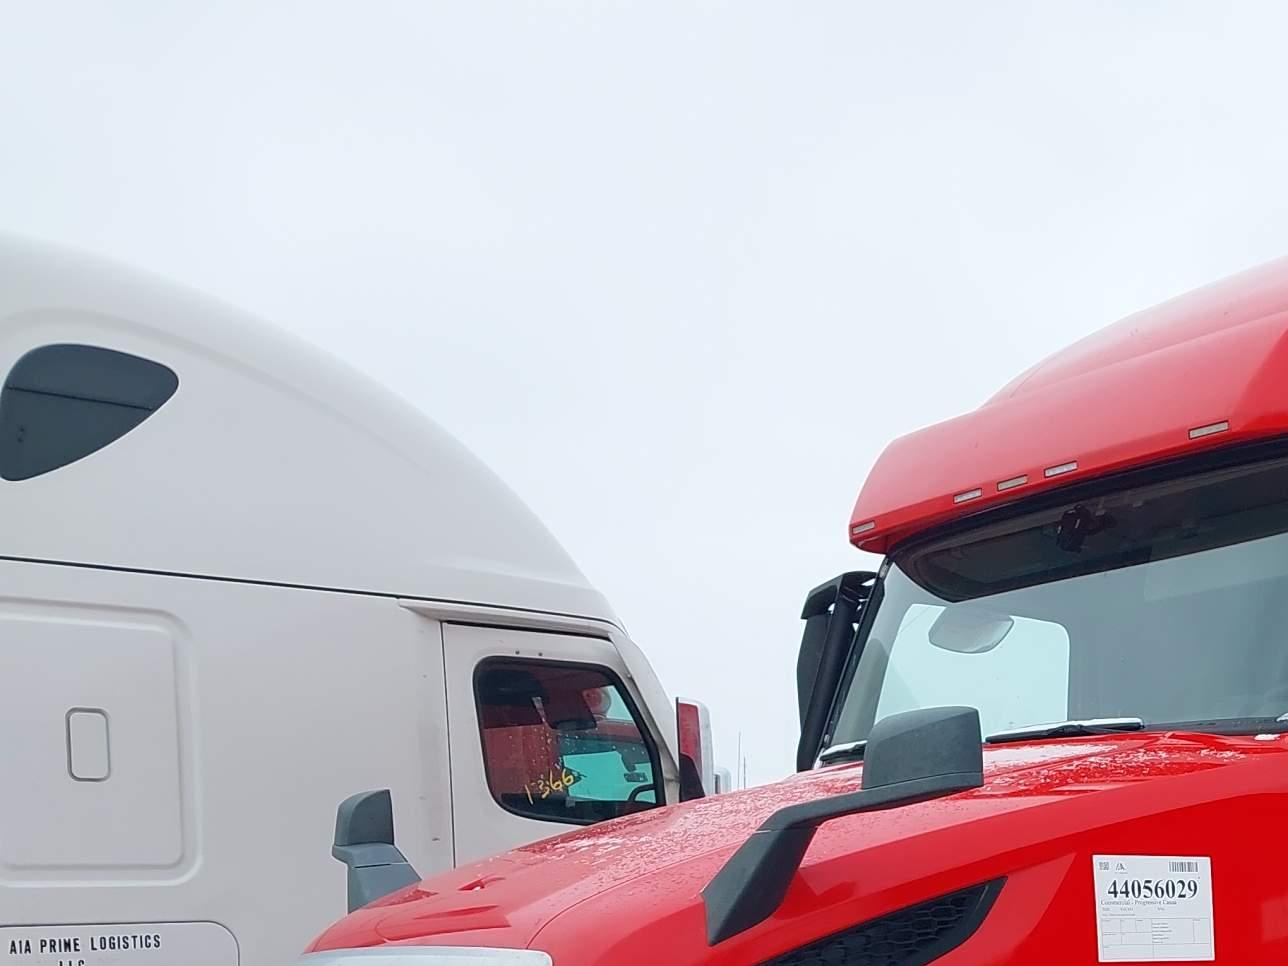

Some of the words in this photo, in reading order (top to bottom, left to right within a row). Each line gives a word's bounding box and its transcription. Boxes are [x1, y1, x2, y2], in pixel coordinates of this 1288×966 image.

[1107, 879, 1198, 899] 44056029
[40, 938, 81, 953] PRIME
[90, 934, 161, 951] LOGISTICS
